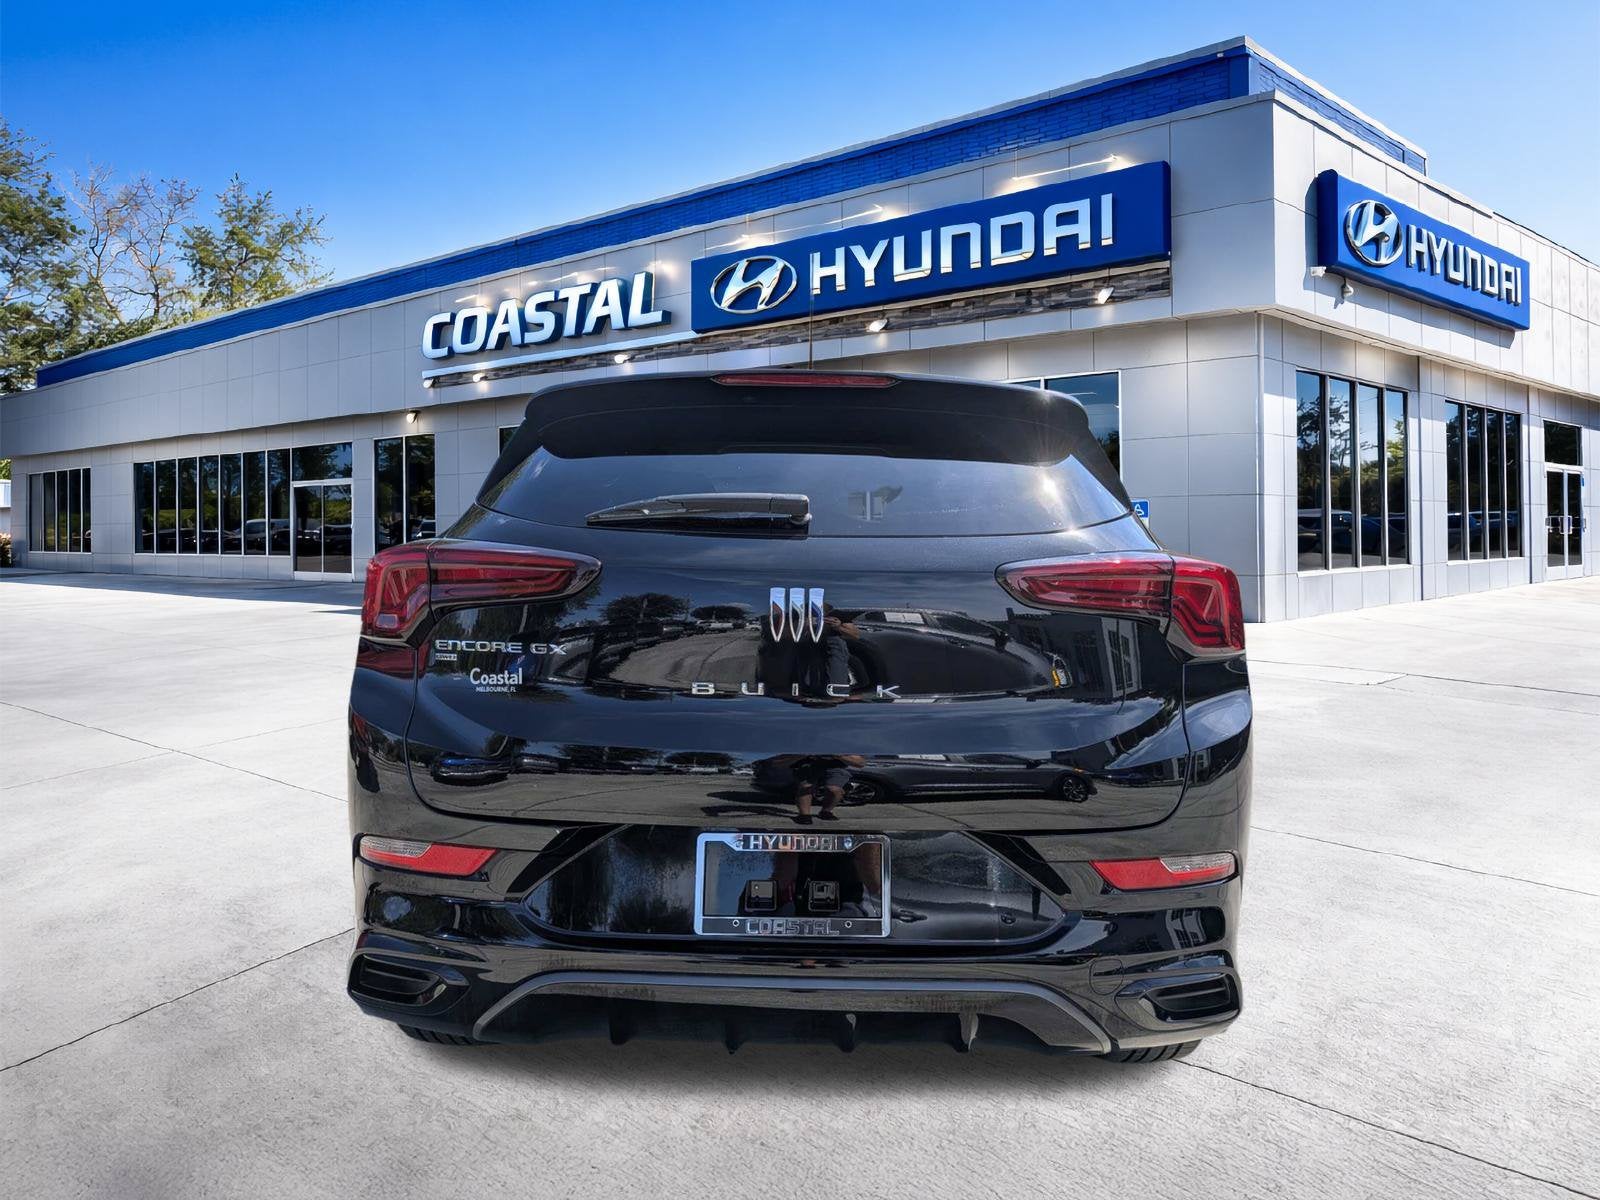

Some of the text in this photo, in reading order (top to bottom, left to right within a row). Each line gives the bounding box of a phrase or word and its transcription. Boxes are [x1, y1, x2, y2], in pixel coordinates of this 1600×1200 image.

[809, 192, 1114, 295] HYUNDAI
[1406, 224, 1523, 306] HYUNDAI
[421, 271, 669, 360] COASTAL
[434, 639, 567, 655] ENCORE GX
[469, 667, 523, 685] Coastal
[691, 681, 902, 699] BUICK
[749, 835, 839, 851] HYUNDAI
[745, 919, 840, 935] COASTAL
